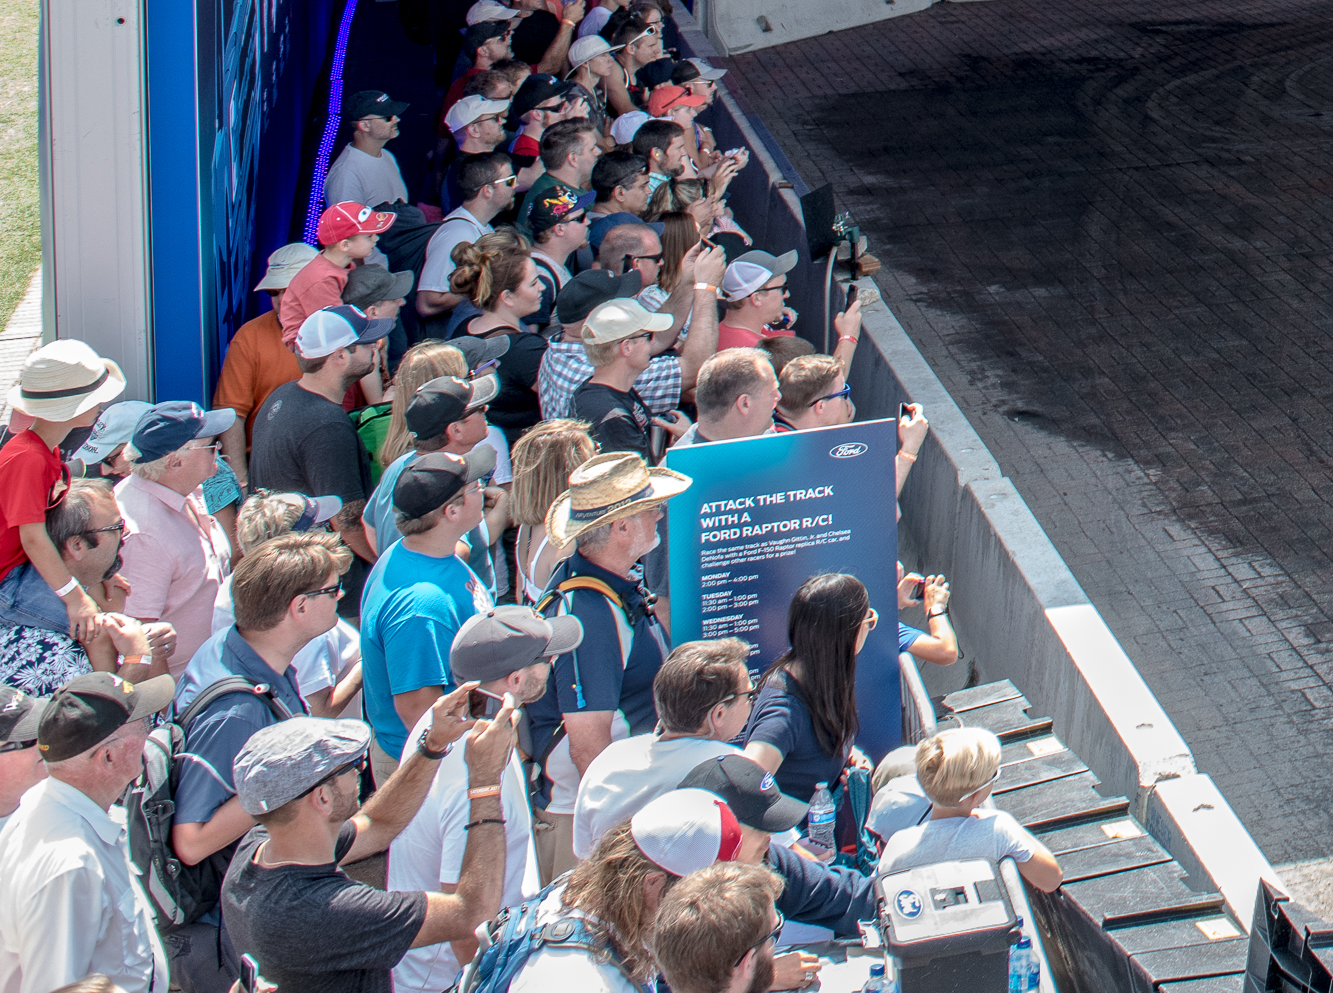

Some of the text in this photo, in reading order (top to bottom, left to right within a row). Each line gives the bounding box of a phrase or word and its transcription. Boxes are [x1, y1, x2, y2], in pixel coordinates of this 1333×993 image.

[836, 444, 861, 457] Ford
[700, 485, 834, 514] ATTACK THE TRACK
[701, 511, 751, 529] WITH A
[701, 514, 833, 543] FORD RAPTOR R/C!
[757, 546, 774, 554] F-150
[775, 543, 795, 552] Raptor
[795, 540, 815, 548] replica
[839, 534, 850, 542] and
[769, 537, 791, 546] Vaughn
[828, 529, 851, 537] Chelsea
[701, 559, 730, 568] challenge
[780, 549, 796, 558] prize!
[701, 571, 731, 581] MONDAY
[702, 580, 716, 588] 2:00
[716, 579, 728, 587] pm
[702, 590, 733, 600] TUESDAY
[702, 605, 717, 613] 2:00
[733, 600, 748, 608] 3:00
[702, 613, 744, 625] WEDNESDAY
[734, 619, 747, 627] 1:00
[747, 618, 758, 626] pm
[702, 630, 717, 639] 3:00
[733, 625, 748, 633] 5:00
